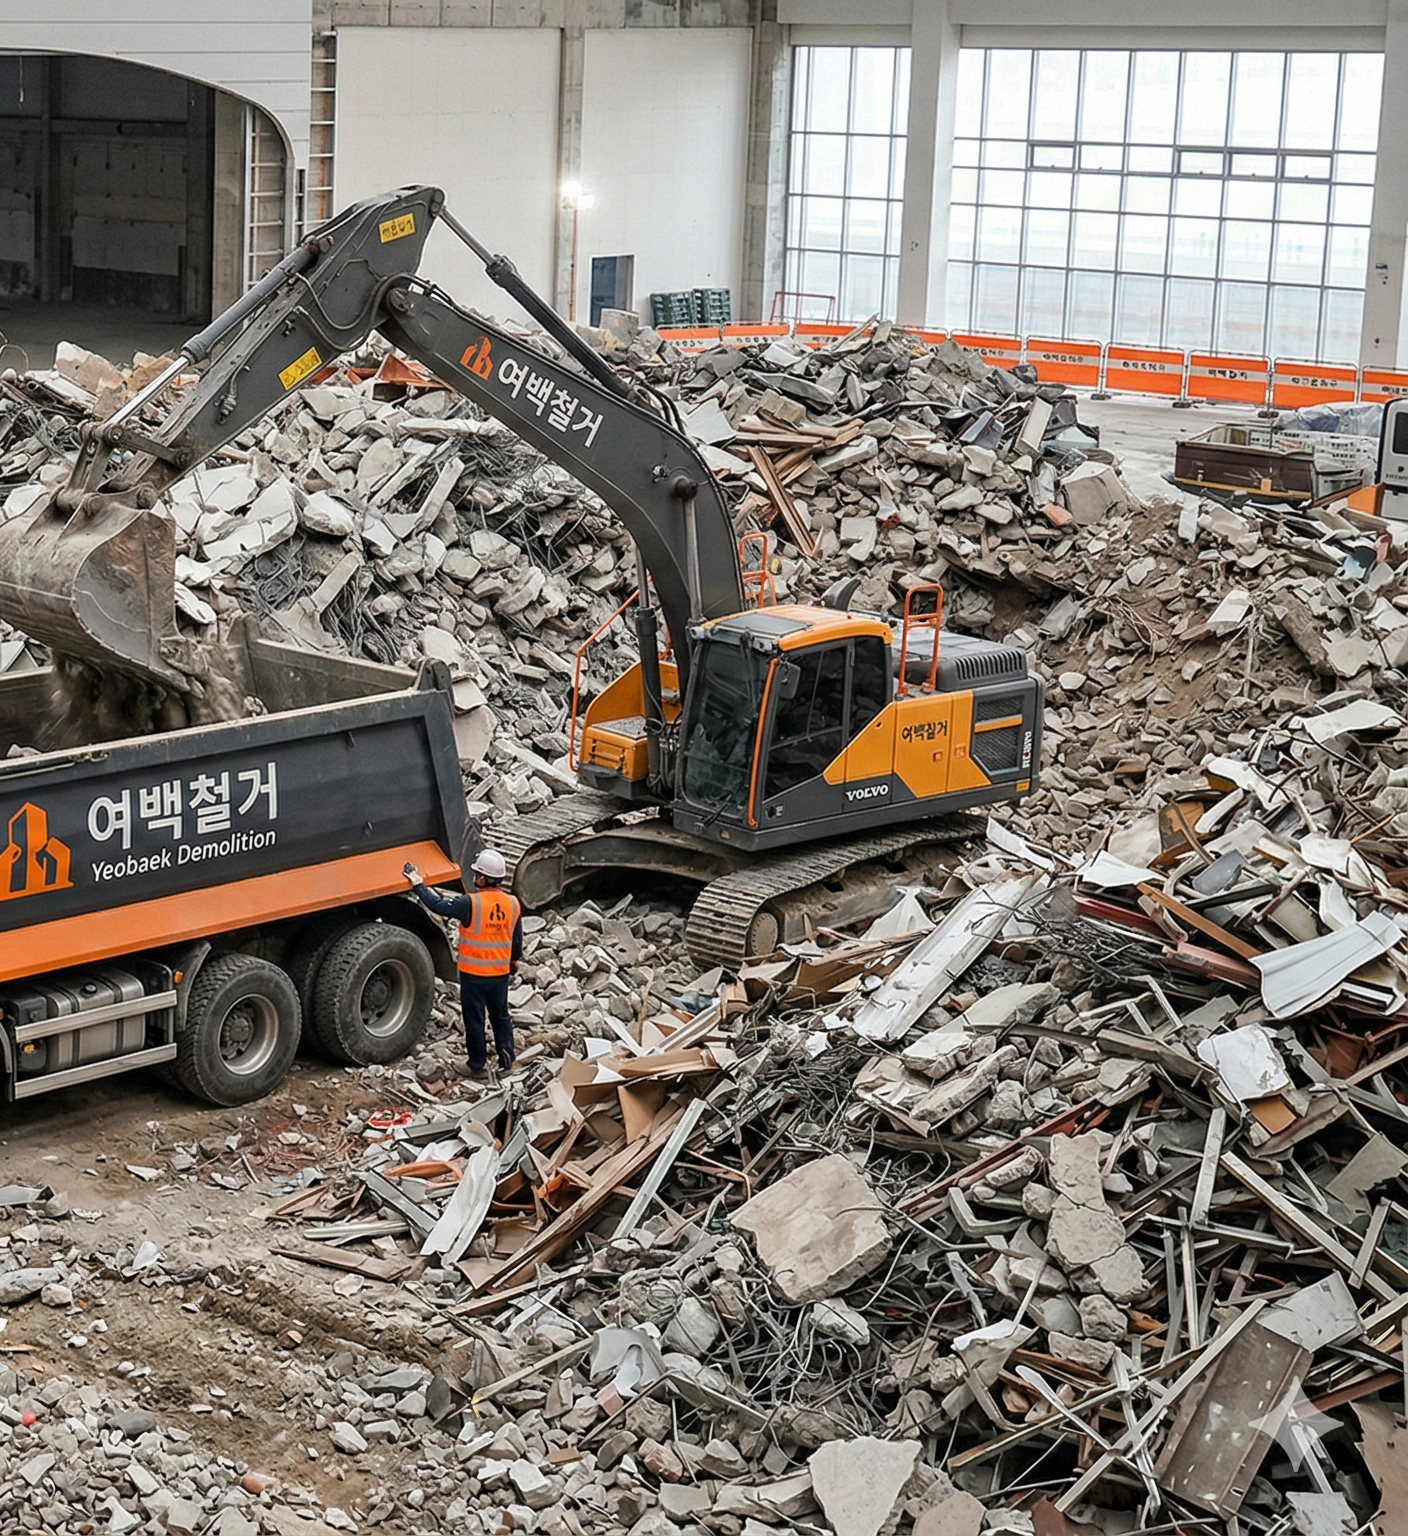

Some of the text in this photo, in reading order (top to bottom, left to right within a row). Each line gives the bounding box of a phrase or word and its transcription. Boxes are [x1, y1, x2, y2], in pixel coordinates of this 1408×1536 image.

[498, 358, 604, 448] 여백철거
[87, 762, 278, 850] 여백철거
[845, 784, 889, 801] VOLVO
[92, 830, 277, 882] Yeobaek Demolition
